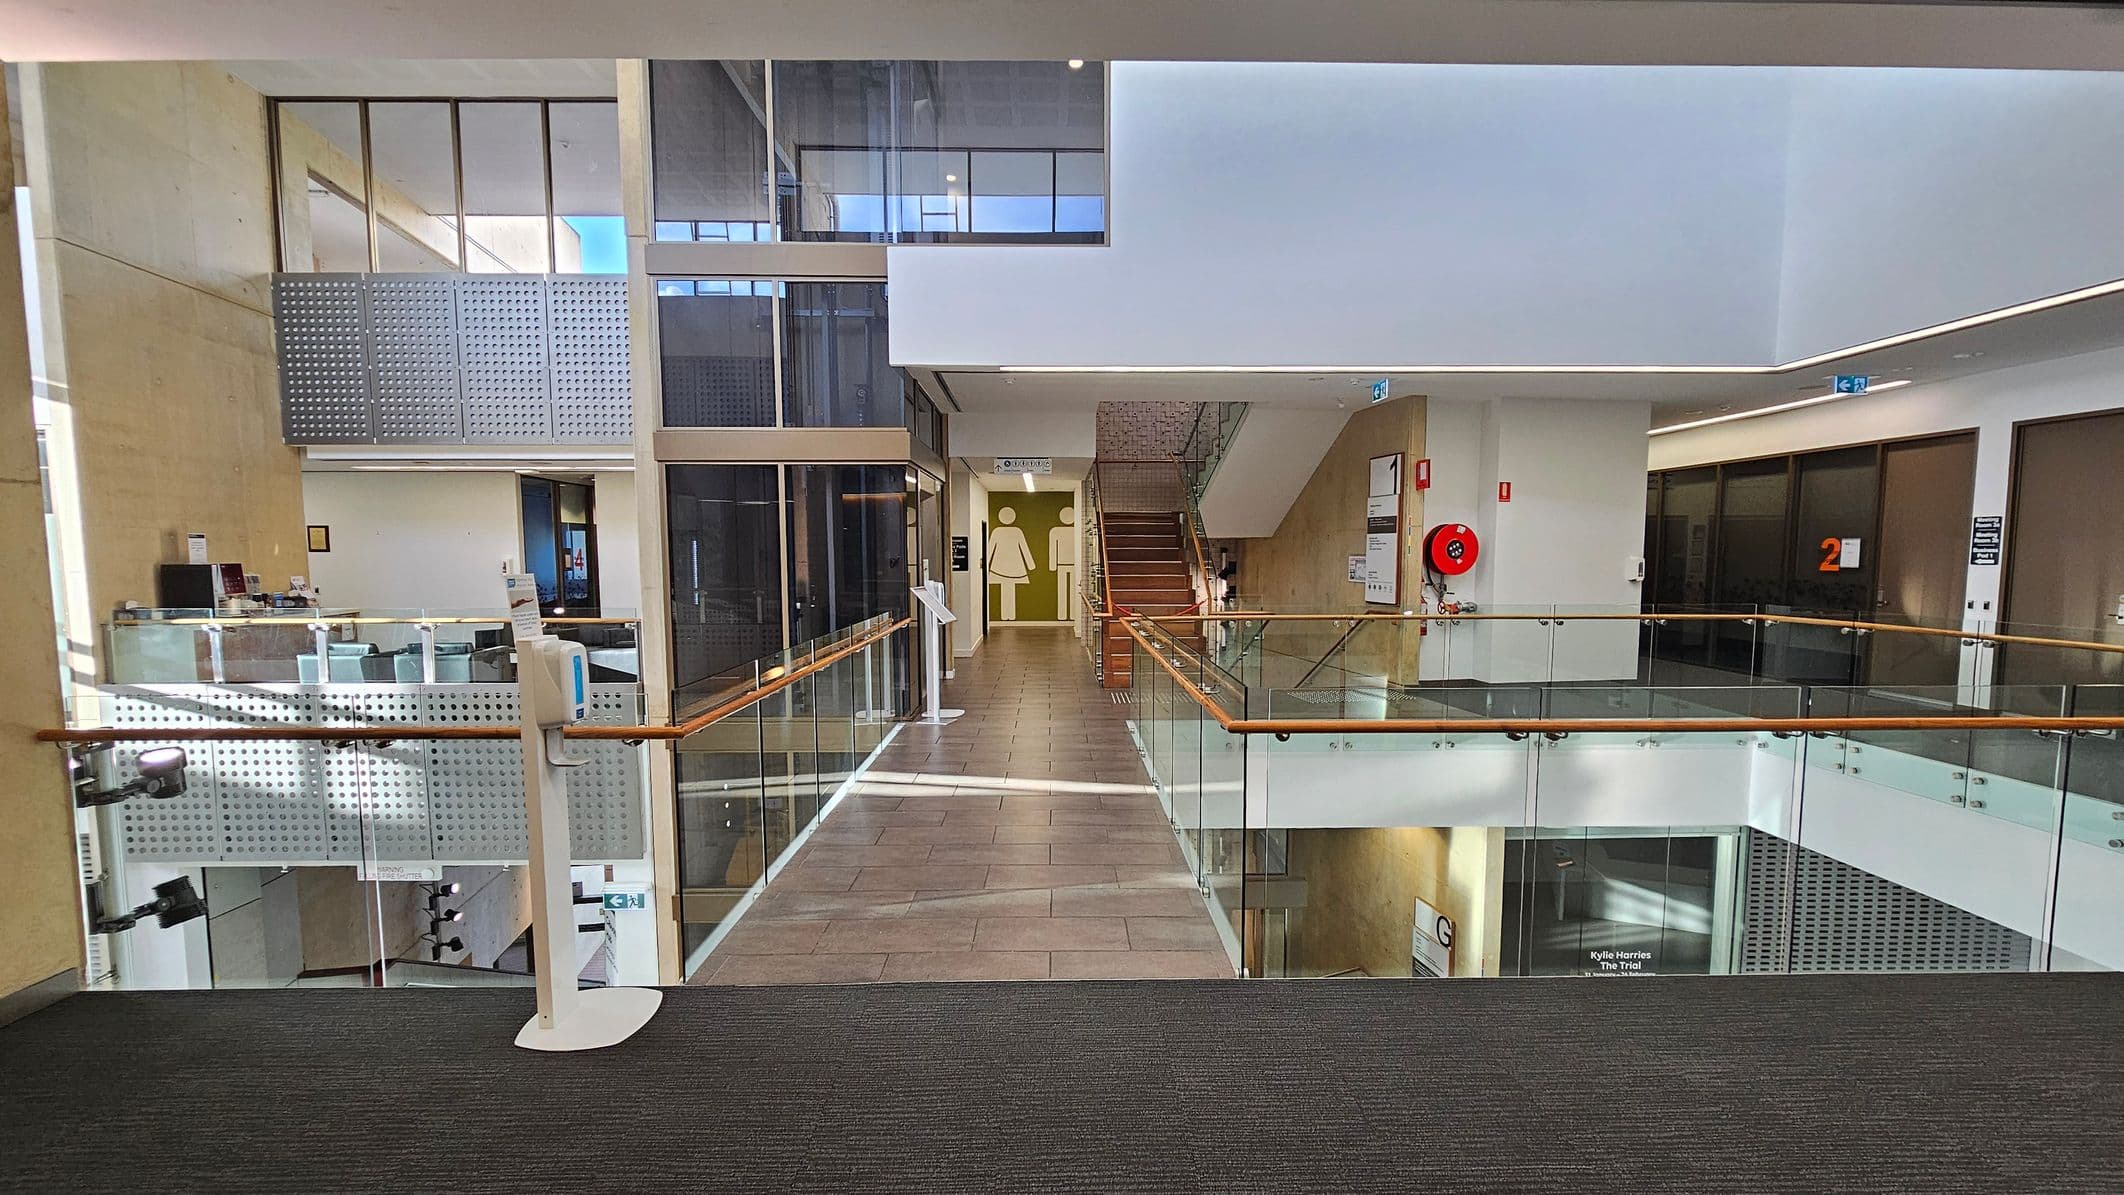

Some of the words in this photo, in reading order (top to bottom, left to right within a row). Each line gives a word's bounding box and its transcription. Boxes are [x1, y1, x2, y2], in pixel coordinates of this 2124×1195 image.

[1389, 455, 1398, 495] 1
[574, 548, 584, 571] 4
[1819, 537, 1841, 571] 2
[1436, 915, 1451, 949] G
[1590, 951, 1615, 961] Kylie
[1616, 951, 1652, 960] Harries
[1600, 961, 1618, 970] The
[1620, 961, 1642, 970] Trial
